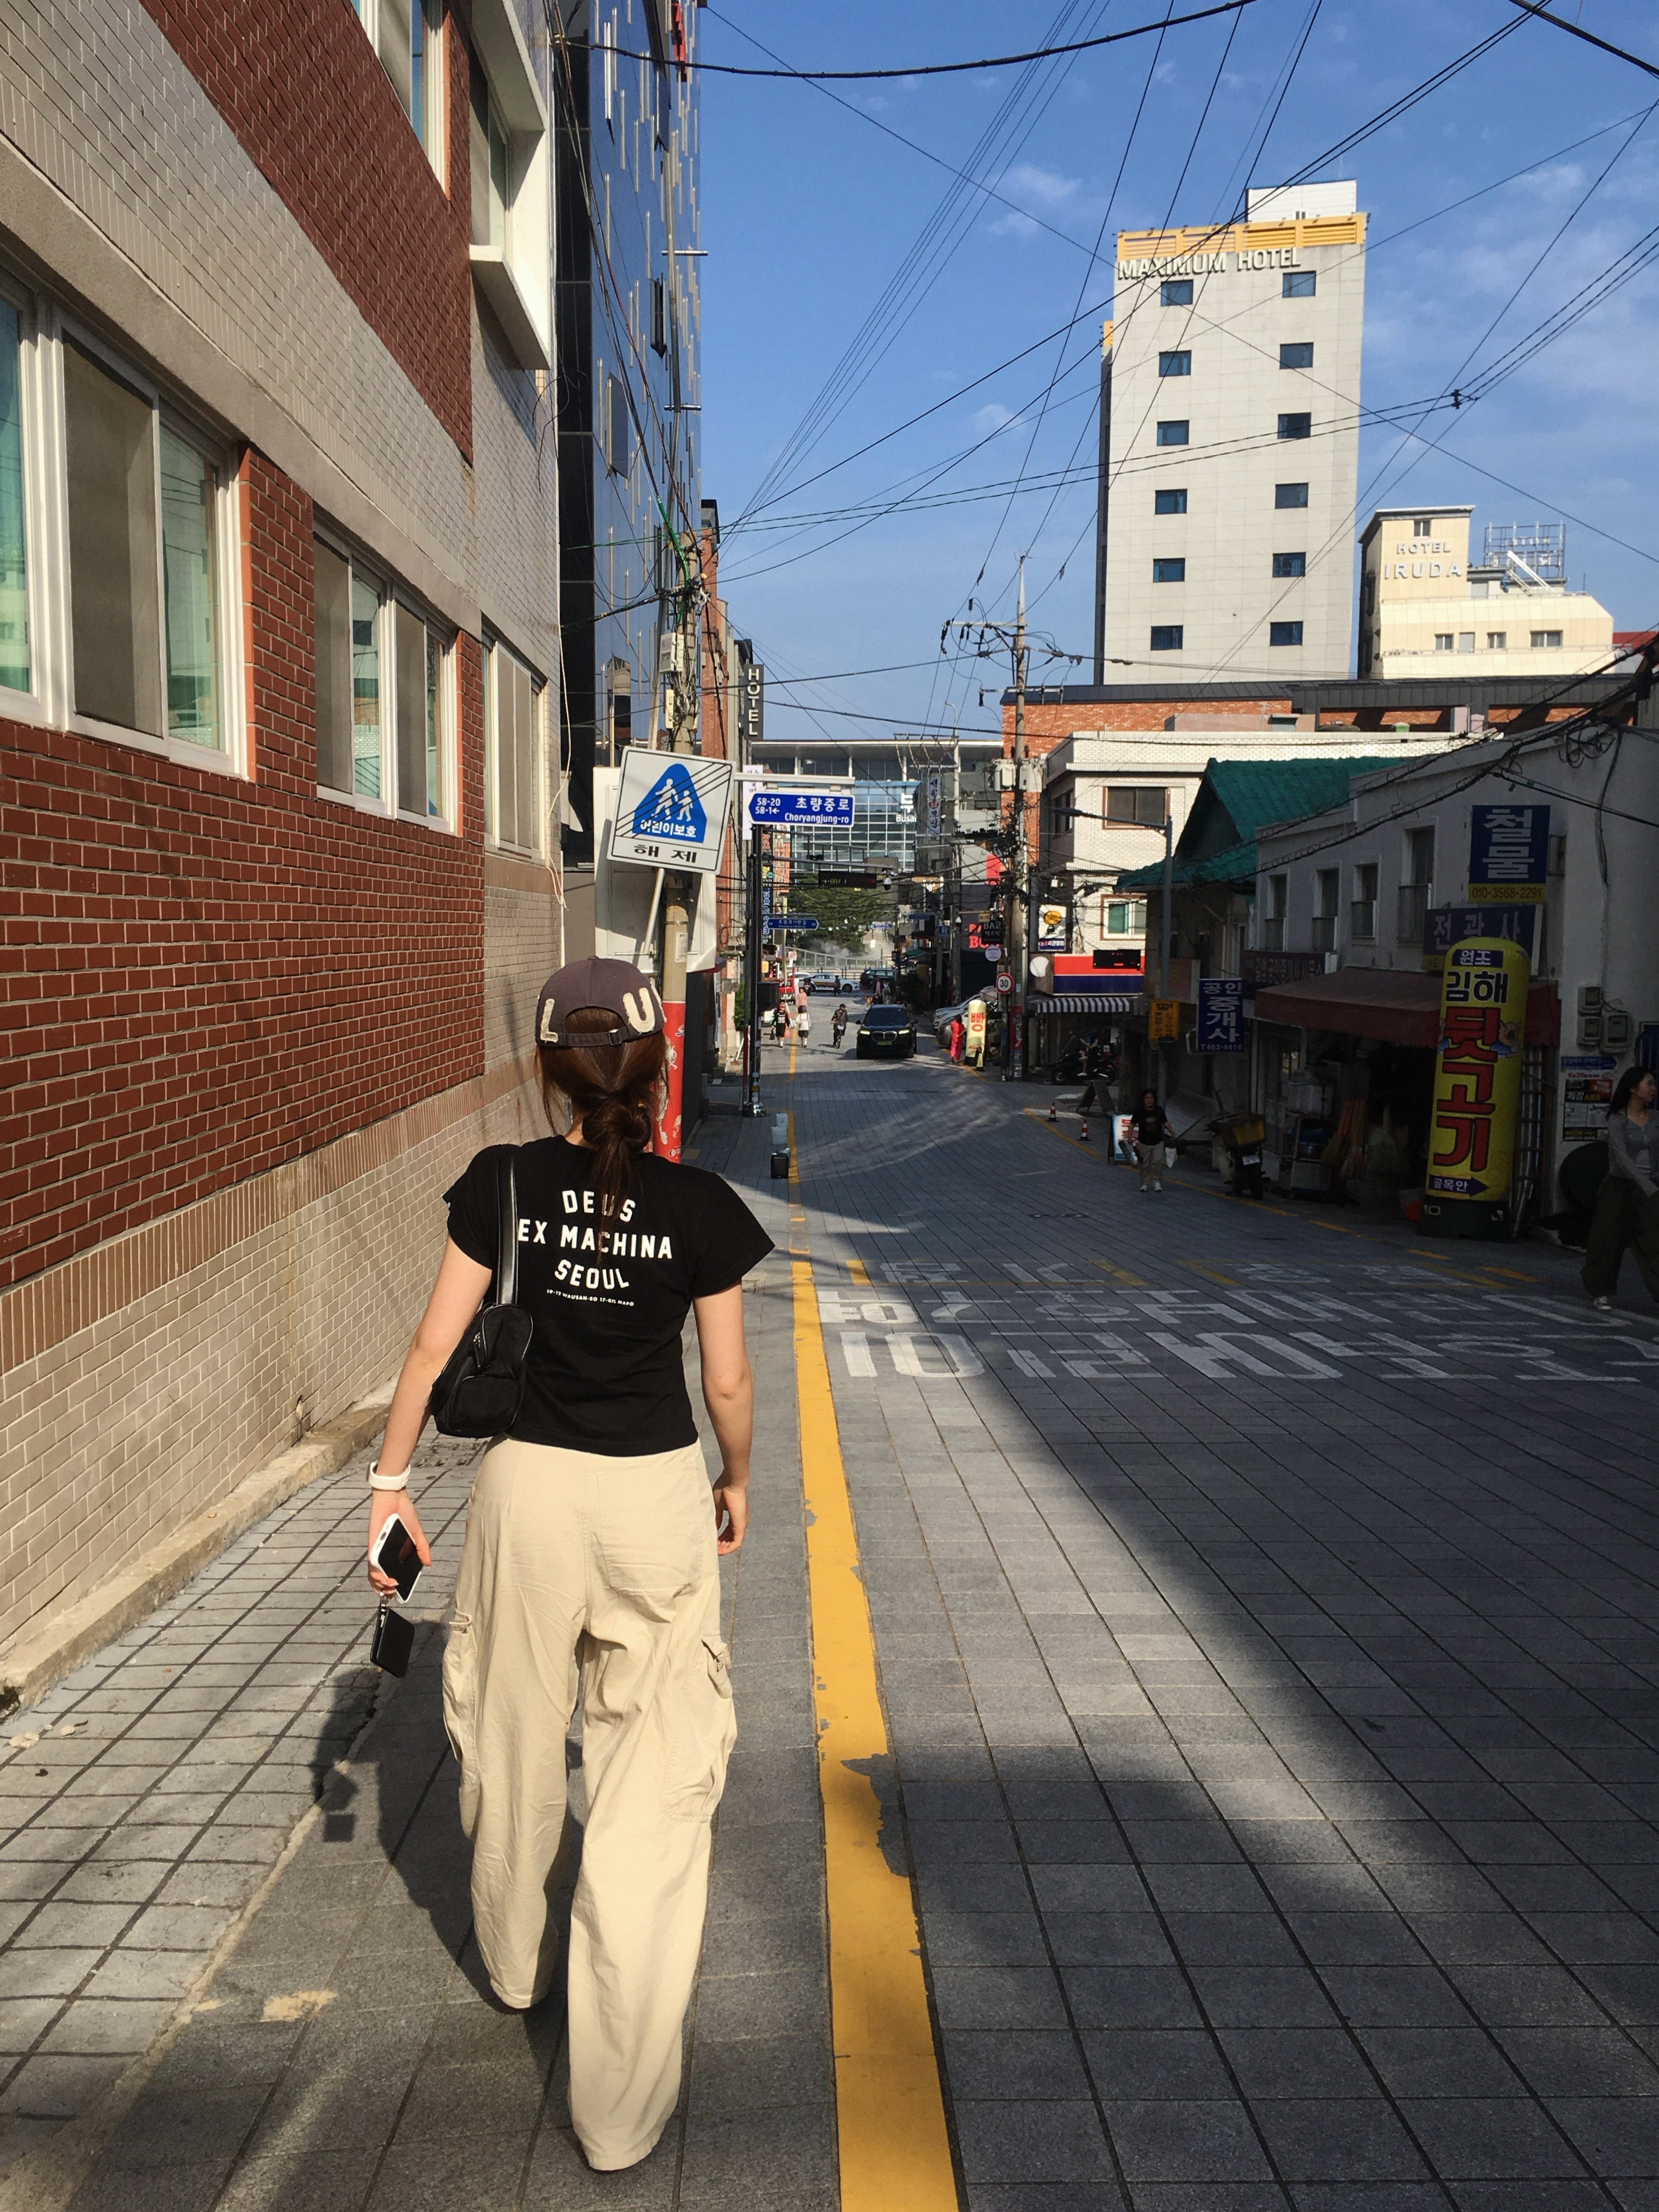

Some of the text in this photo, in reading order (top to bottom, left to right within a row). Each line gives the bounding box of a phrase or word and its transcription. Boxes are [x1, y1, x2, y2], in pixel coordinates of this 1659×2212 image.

[1118, 248, 1302, 280] MAXIMUM HOTEL
[1396, 541, 1452, 554] HOTEL
[1385, 561, 1462, 579] IRUDA
[748, 669, 761, 736] HOTEL
[757, 797, 781, 807] 58-20
[795, 796, 850, 812] 초량중로
[784, 813, 849, 824] Choryangjung-ro
[640, 819, 697, 838] 어린이보호
[1482, 808, 1535, 879] 철물
[1471, 887, 1542, 899] 010-3568-2291
[1460, 950, 1491, 966] 원조
[1000, 979, 1009, 988] 30
[1445, 970, 1509, 1003] 김해
[623, 987, 656, 1033] U
[971, 1012, 985, 1032] 빵
[1433, 1006, 1502, 1172] 뒷고기
[1434, 1177, 1469, 1193] 골목안
[562, 1190, 636, 1223] DEUS
[517, 1218, 673, 1259] EX MACHINA
[554, 1259, 629, 1290] SEOUL
[562, 1293, 598, 1302] WAUSAN-RO
